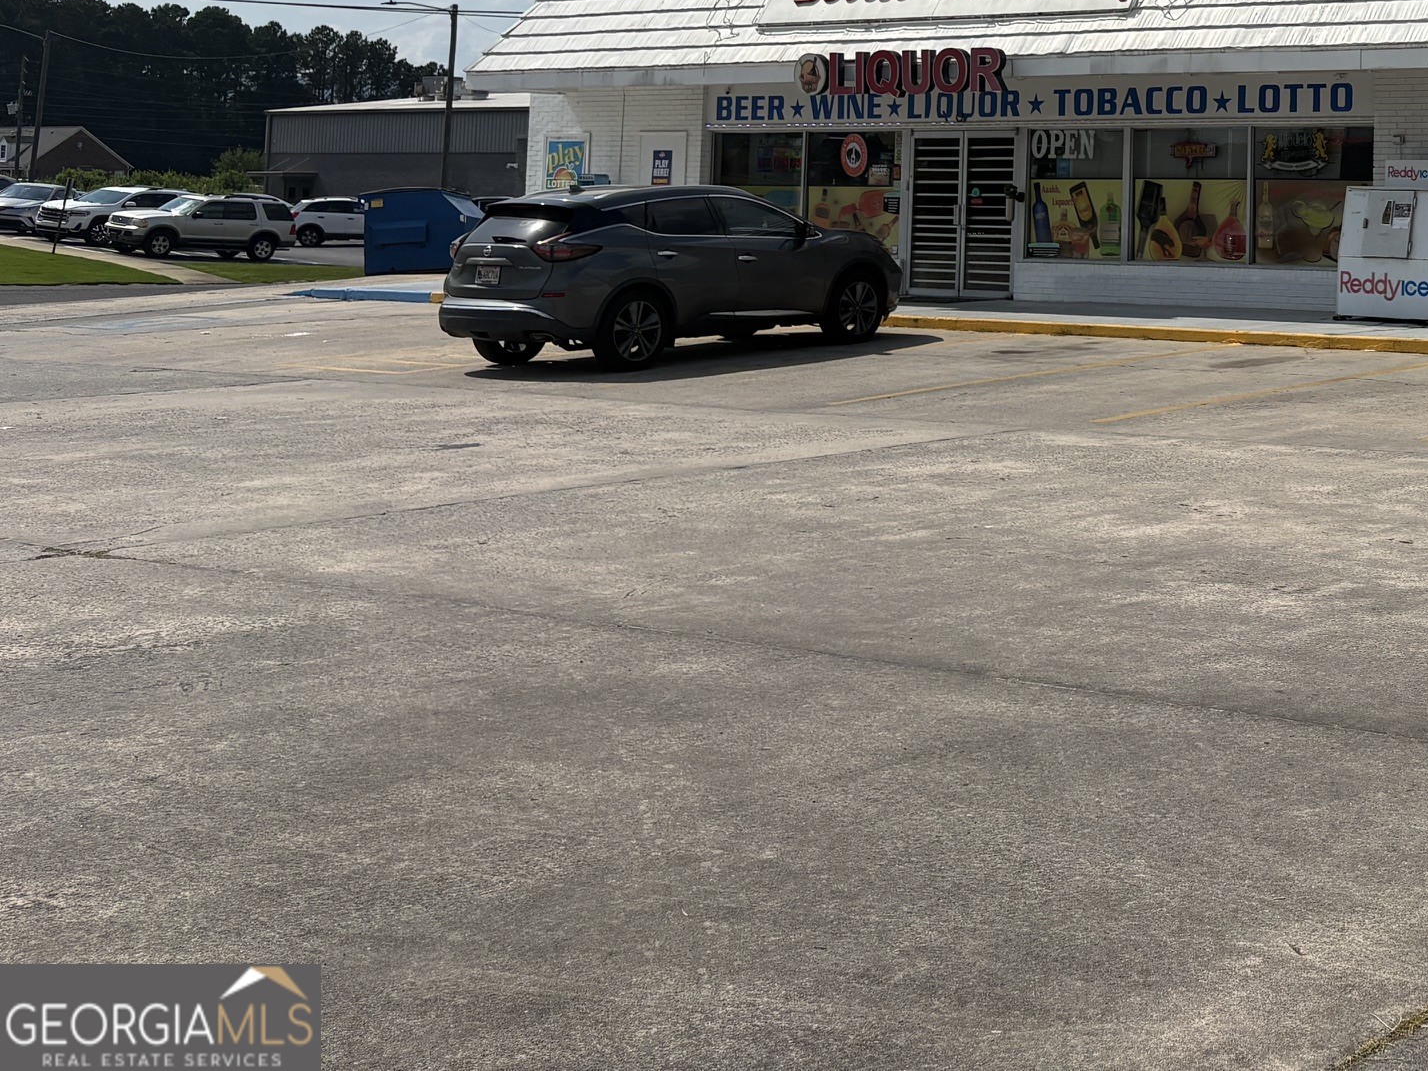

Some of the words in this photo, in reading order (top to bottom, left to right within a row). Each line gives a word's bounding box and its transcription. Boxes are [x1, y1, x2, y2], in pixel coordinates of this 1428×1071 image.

[829, 47, 1003, 97] LIQUOR
[716, 95, 785, 121] BEER
[811, 92, 882, 119] WINE
[907, 90, 1020, 121] LIQUOR
[1053, 86, 1207, 116] TOBACCO
[1237, 82, 1353, 113] LOTTO
[548, 144, 584, 174] play
[1031, 130, 1096, 159] OPEN
[654, 159, 669, 168] PLAY
